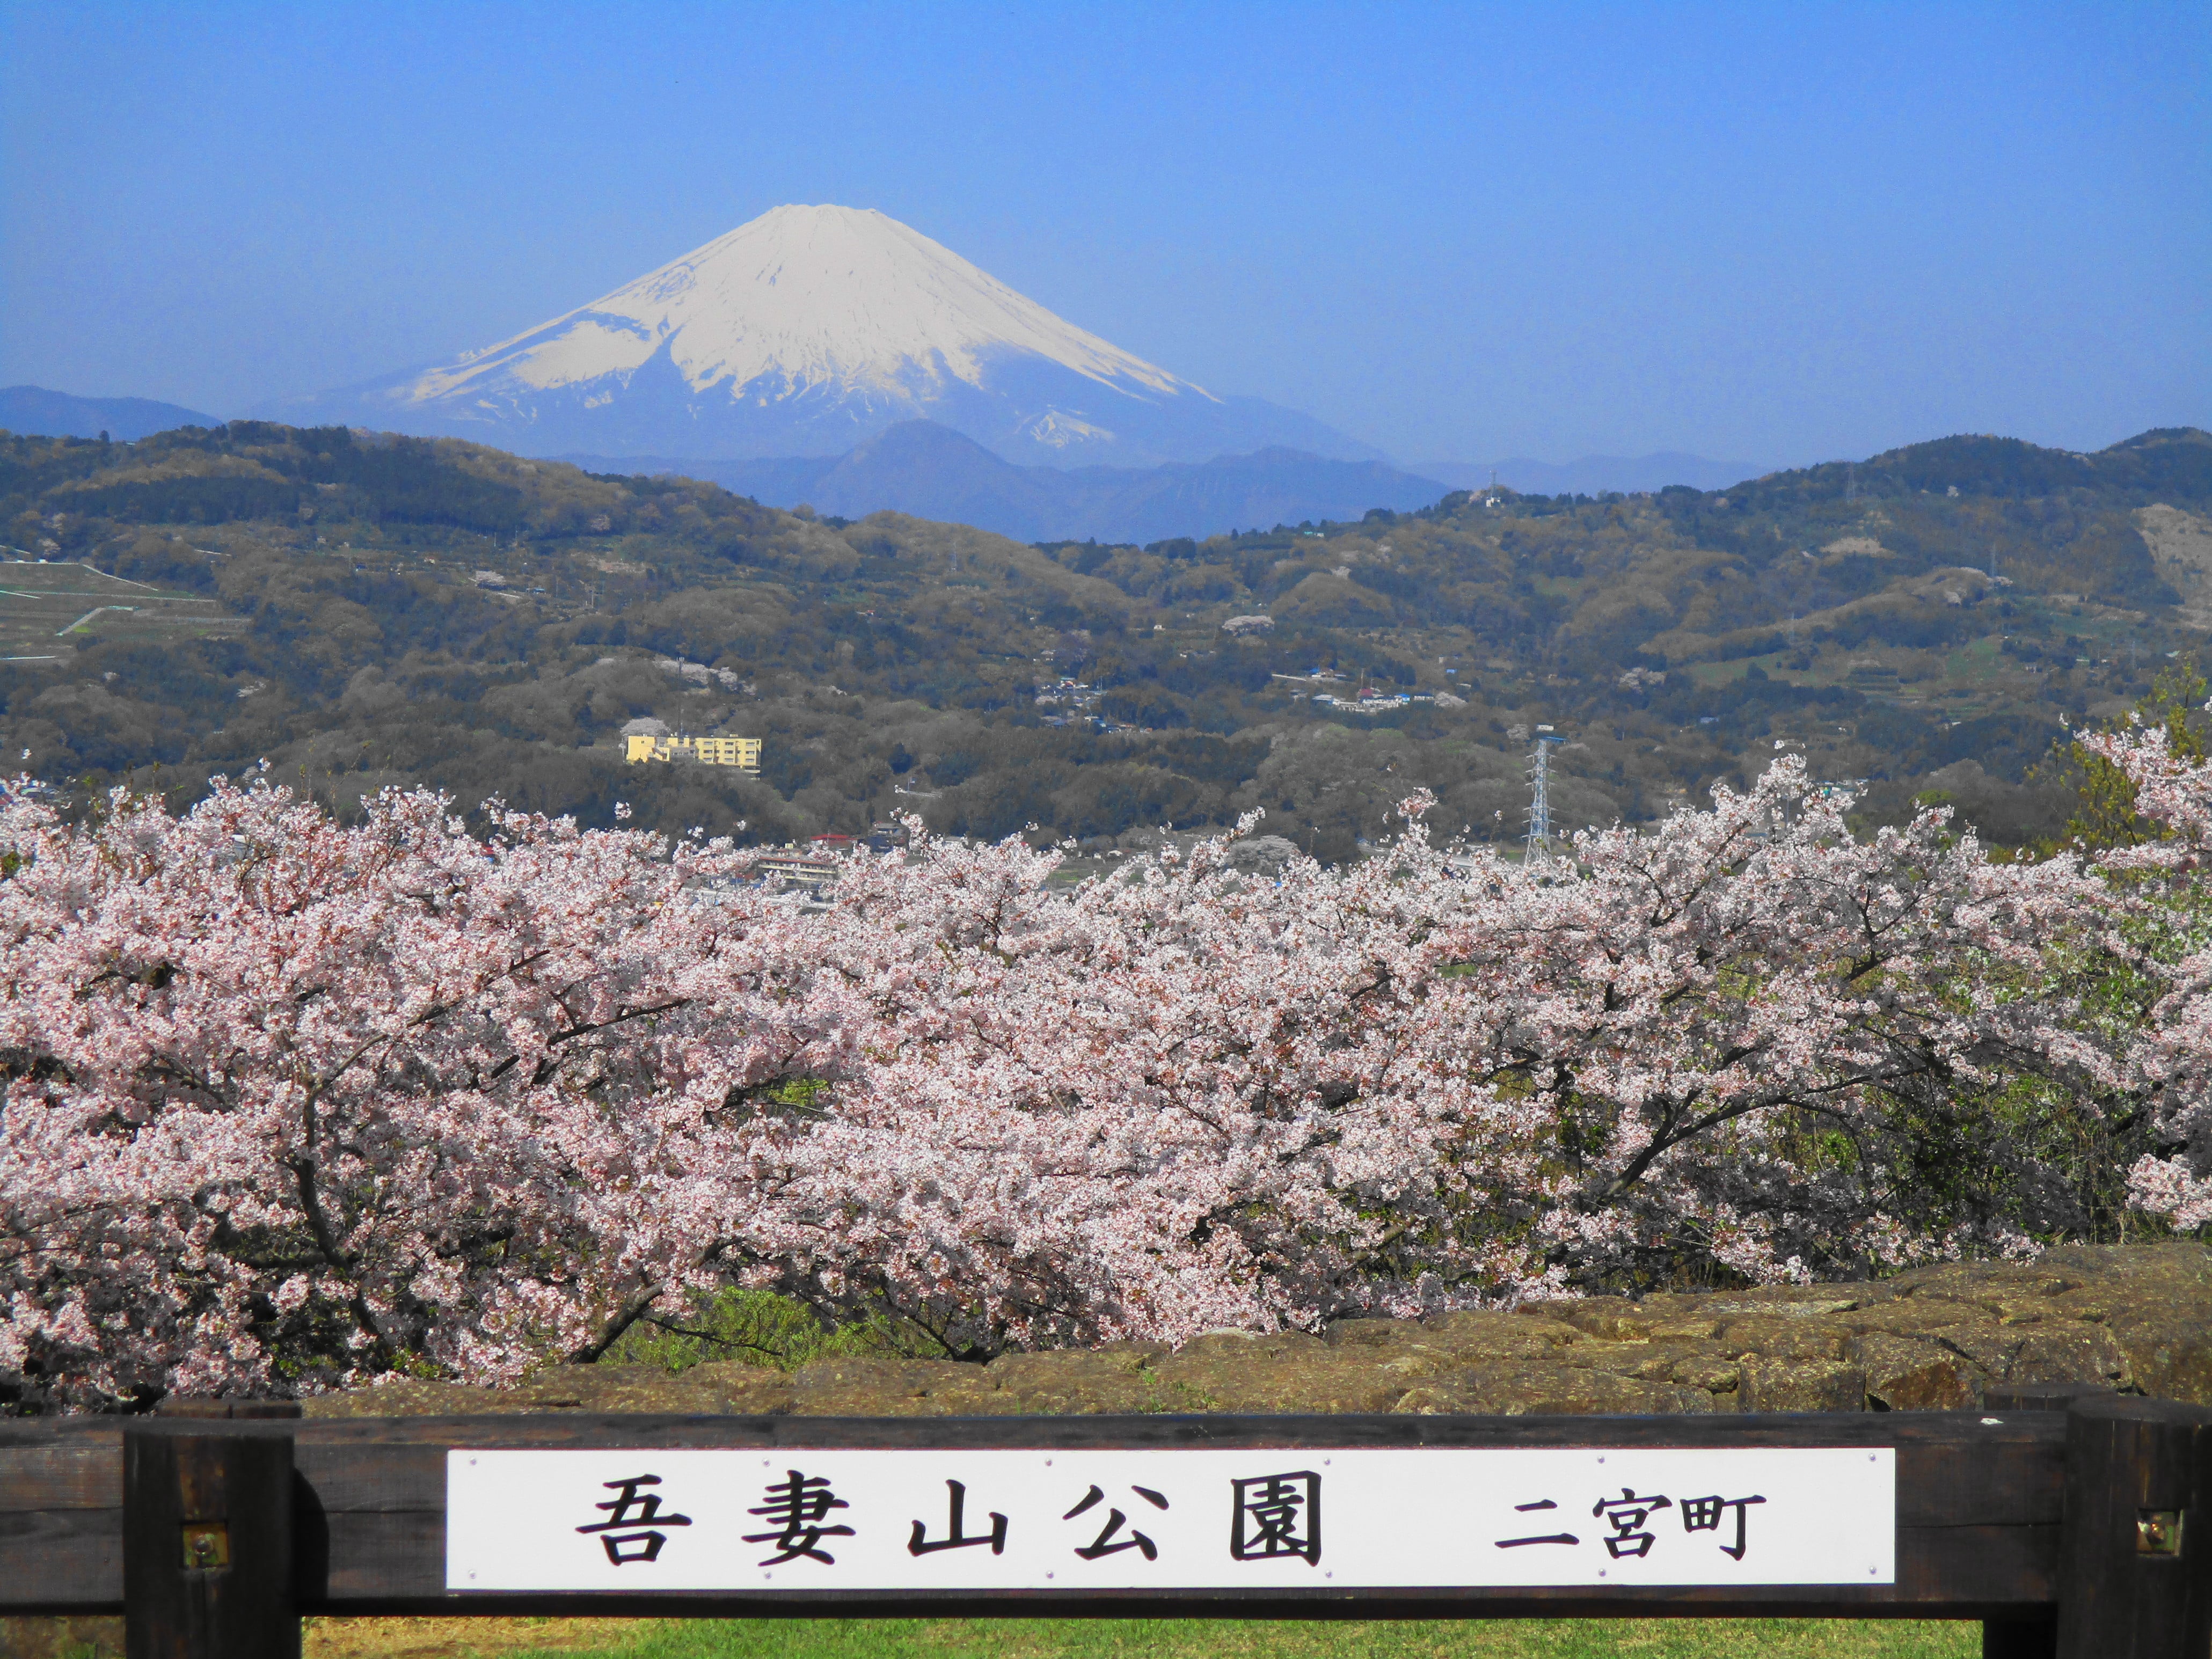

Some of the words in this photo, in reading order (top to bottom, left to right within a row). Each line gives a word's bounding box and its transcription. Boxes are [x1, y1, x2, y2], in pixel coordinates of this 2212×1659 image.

[575, 1470, 1322, 1567] 吾妻山公園
[1494, 1487, 1766, 1561] 二宮町
